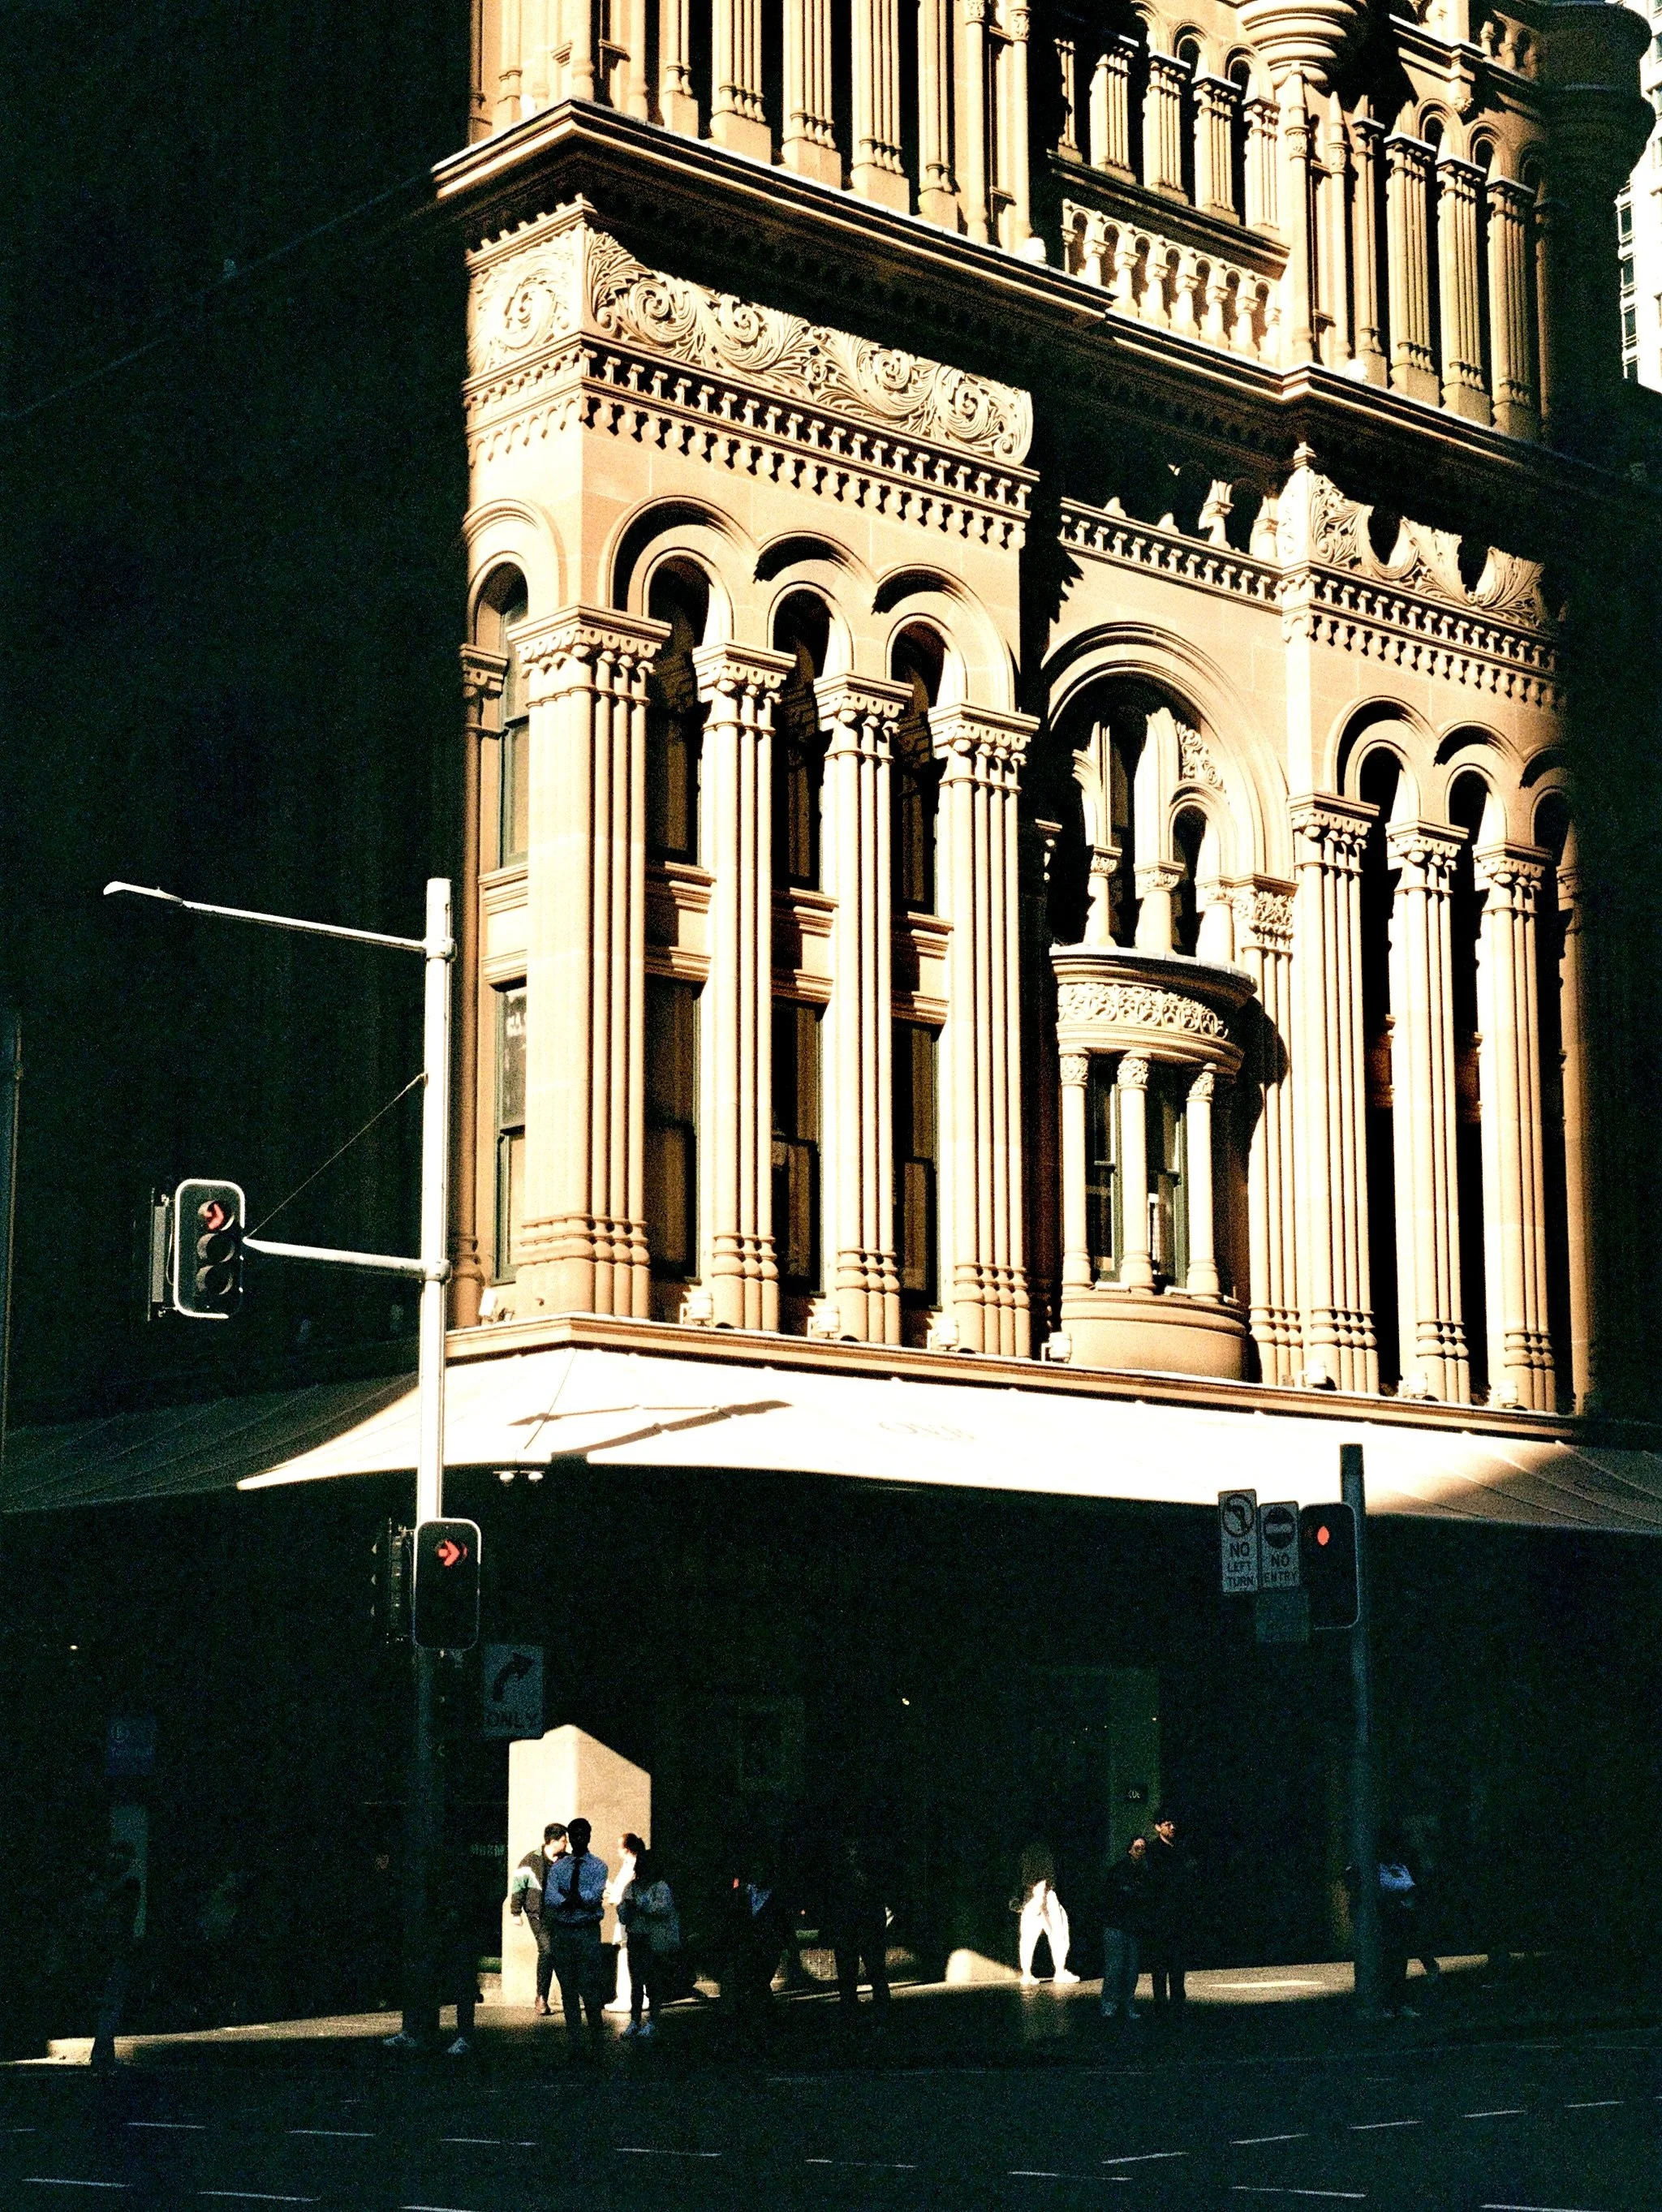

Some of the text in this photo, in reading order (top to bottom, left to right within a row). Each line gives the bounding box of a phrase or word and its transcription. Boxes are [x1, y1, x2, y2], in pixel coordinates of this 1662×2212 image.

[1229, 1542, 1251, 1557] NO
[1227, 1561, 1252, 1573] LEFT
[1271, 1553, 1290, 1568] NO
[1228, 1576, 1255, 1587] TURN
[1264, 1572, 1298, 1583] ENTRY
[487, 1711, 539, 1728] ONLY
